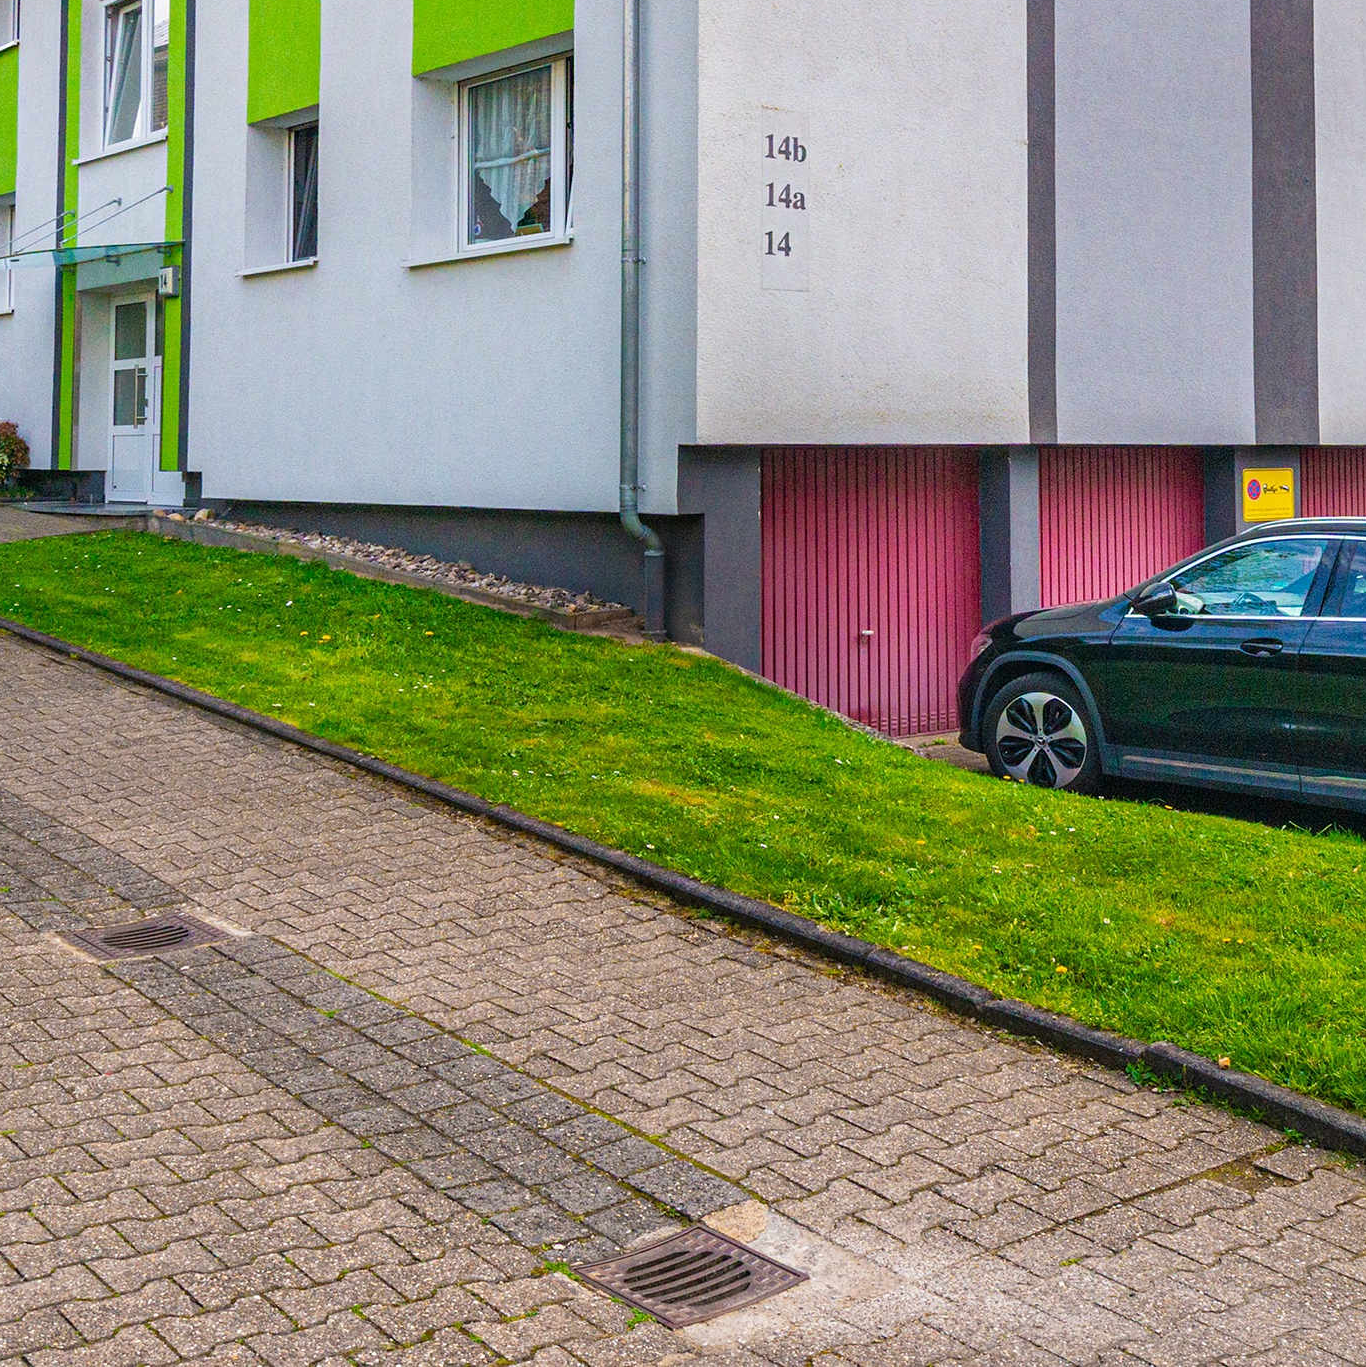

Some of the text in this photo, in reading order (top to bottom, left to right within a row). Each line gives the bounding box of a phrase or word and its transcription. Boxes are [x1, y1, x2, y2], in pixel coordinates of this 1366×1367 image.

[765, 134, 807, 162] 14b
[765, 182, 806, 210] 14a
[764, 230, 792, 256] 14
[160, 274, 167, 288] 14
